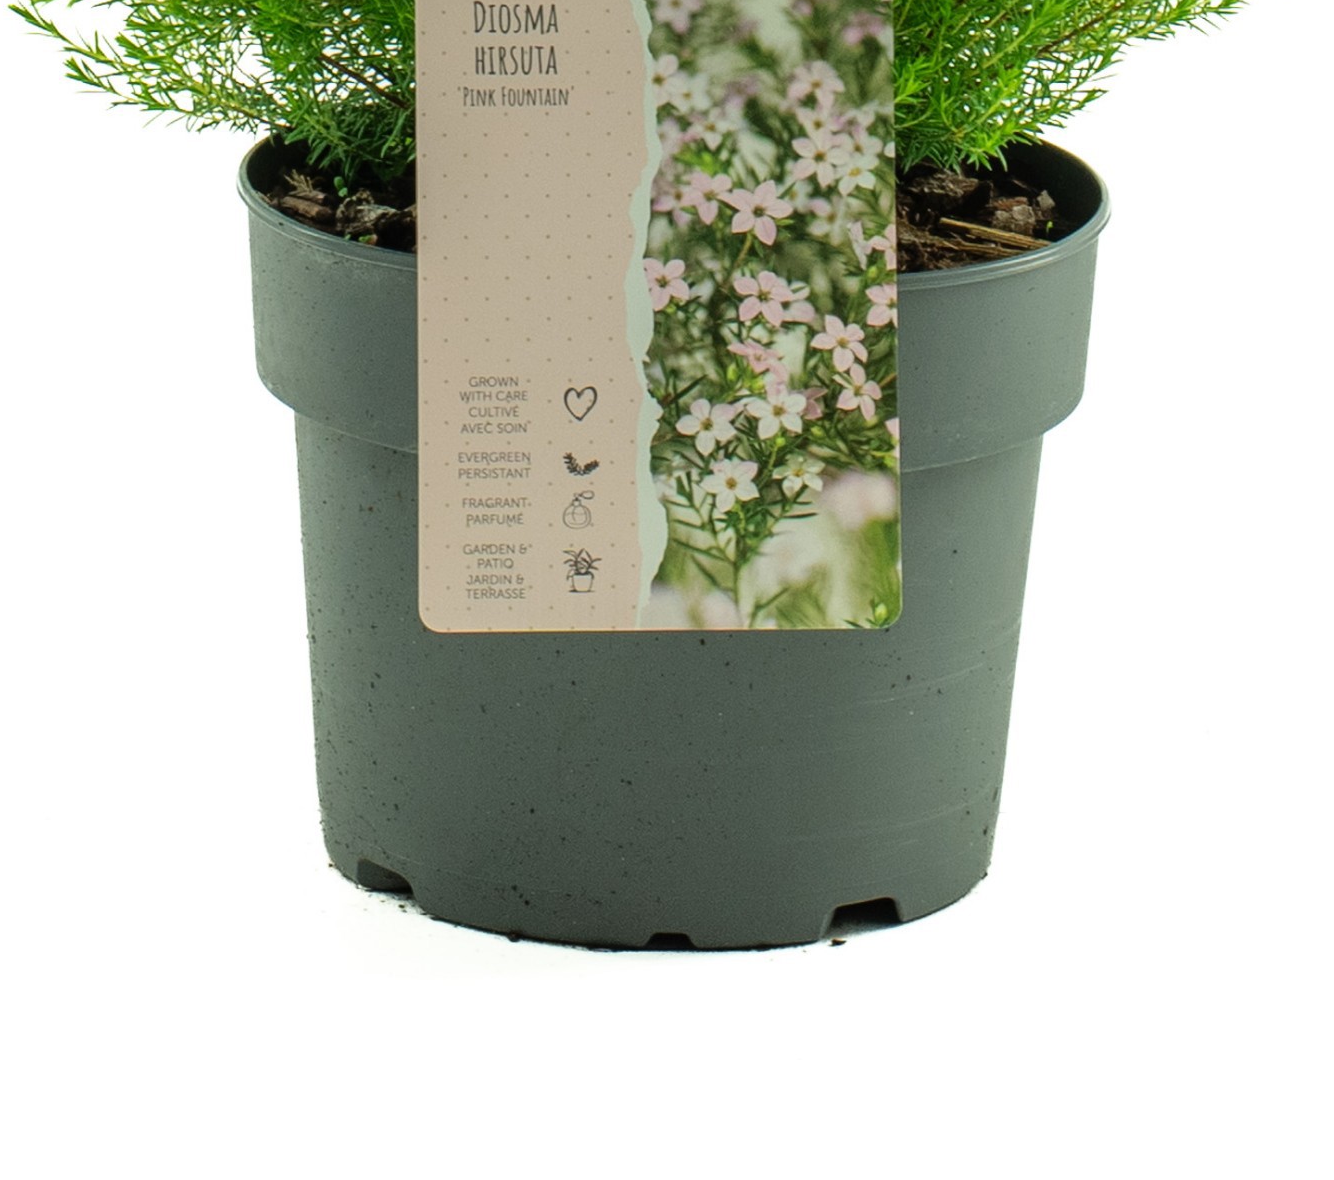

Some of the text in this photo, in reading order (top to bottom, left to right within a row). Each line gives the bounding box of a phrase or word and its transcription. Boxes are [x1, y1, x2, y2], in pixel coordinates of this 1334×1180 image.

[474, 45, 558, 76] HIRSUTA
[468, 376, 519, 387] GROWN
[459, 390, 528, 401] WITH CARE
[460, 422, 528, 434] AVEC SOIN
[458, 451, 531, 463] EVERGREEN
[458, 468, 531, 479] PERSISTANT
[462, 497, 528, 508] FRAGRANT
[466, 512, 524, 525] PARFUMÉ
[462, 543, 527, 555] GARDEN &
[477, 557, 514, 569] PATIO
[466, 573, 524, 585] JARDIN &
[466, 588, 527, 599] TERRASSE
